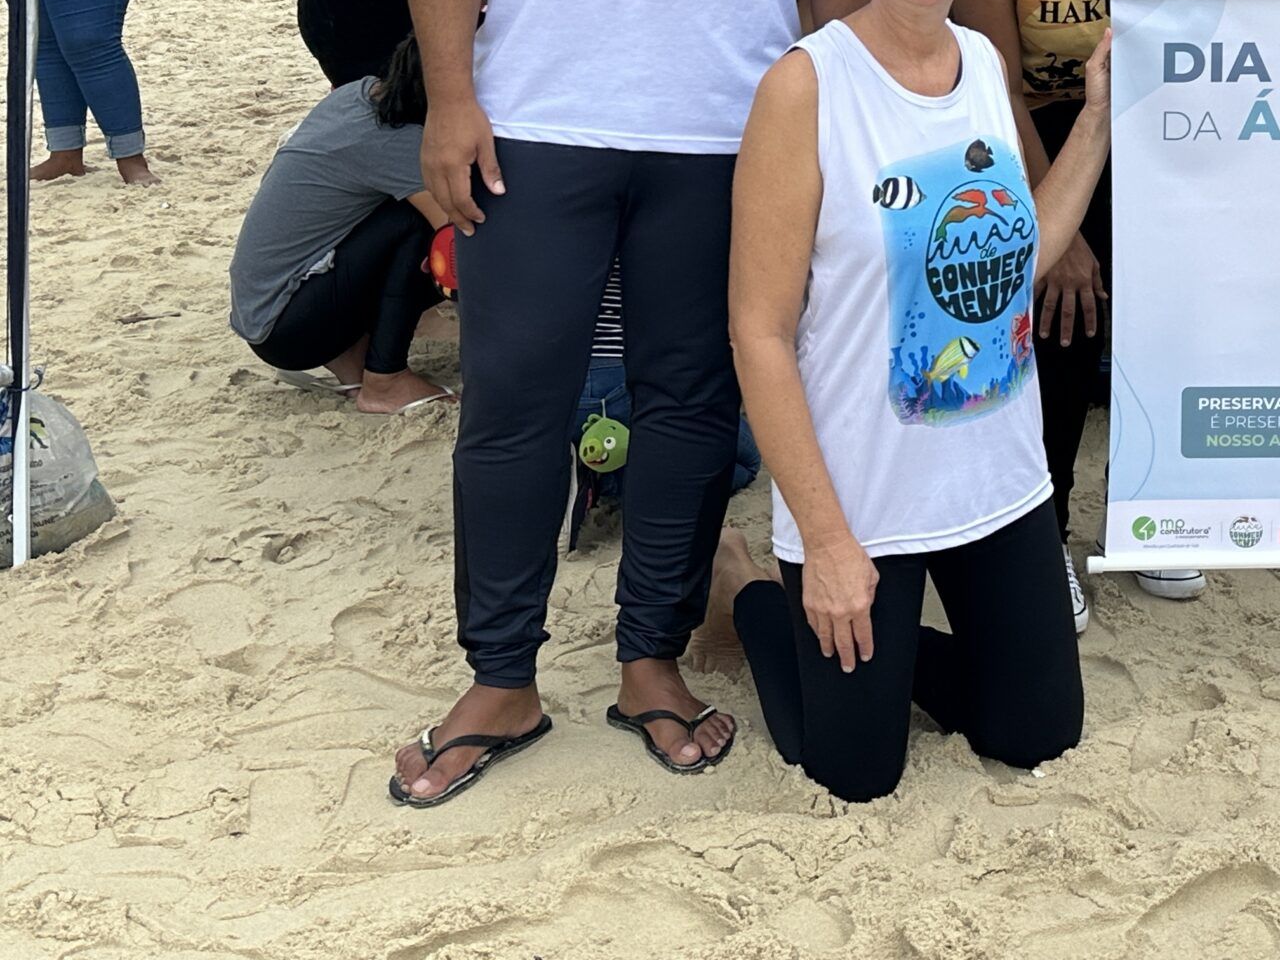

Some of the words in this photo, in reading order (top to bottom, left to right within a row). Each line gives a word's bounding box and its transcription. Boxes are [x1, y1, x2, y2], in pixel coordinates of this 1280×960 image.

[1163, 42, 1272, 84] DIA
[1163, 111, 1222, 141] DA
[980, 242, 998, 259] de
[1210, 414, 1220, 429] É
[1206, 434, 1265, 448] NOSSO
